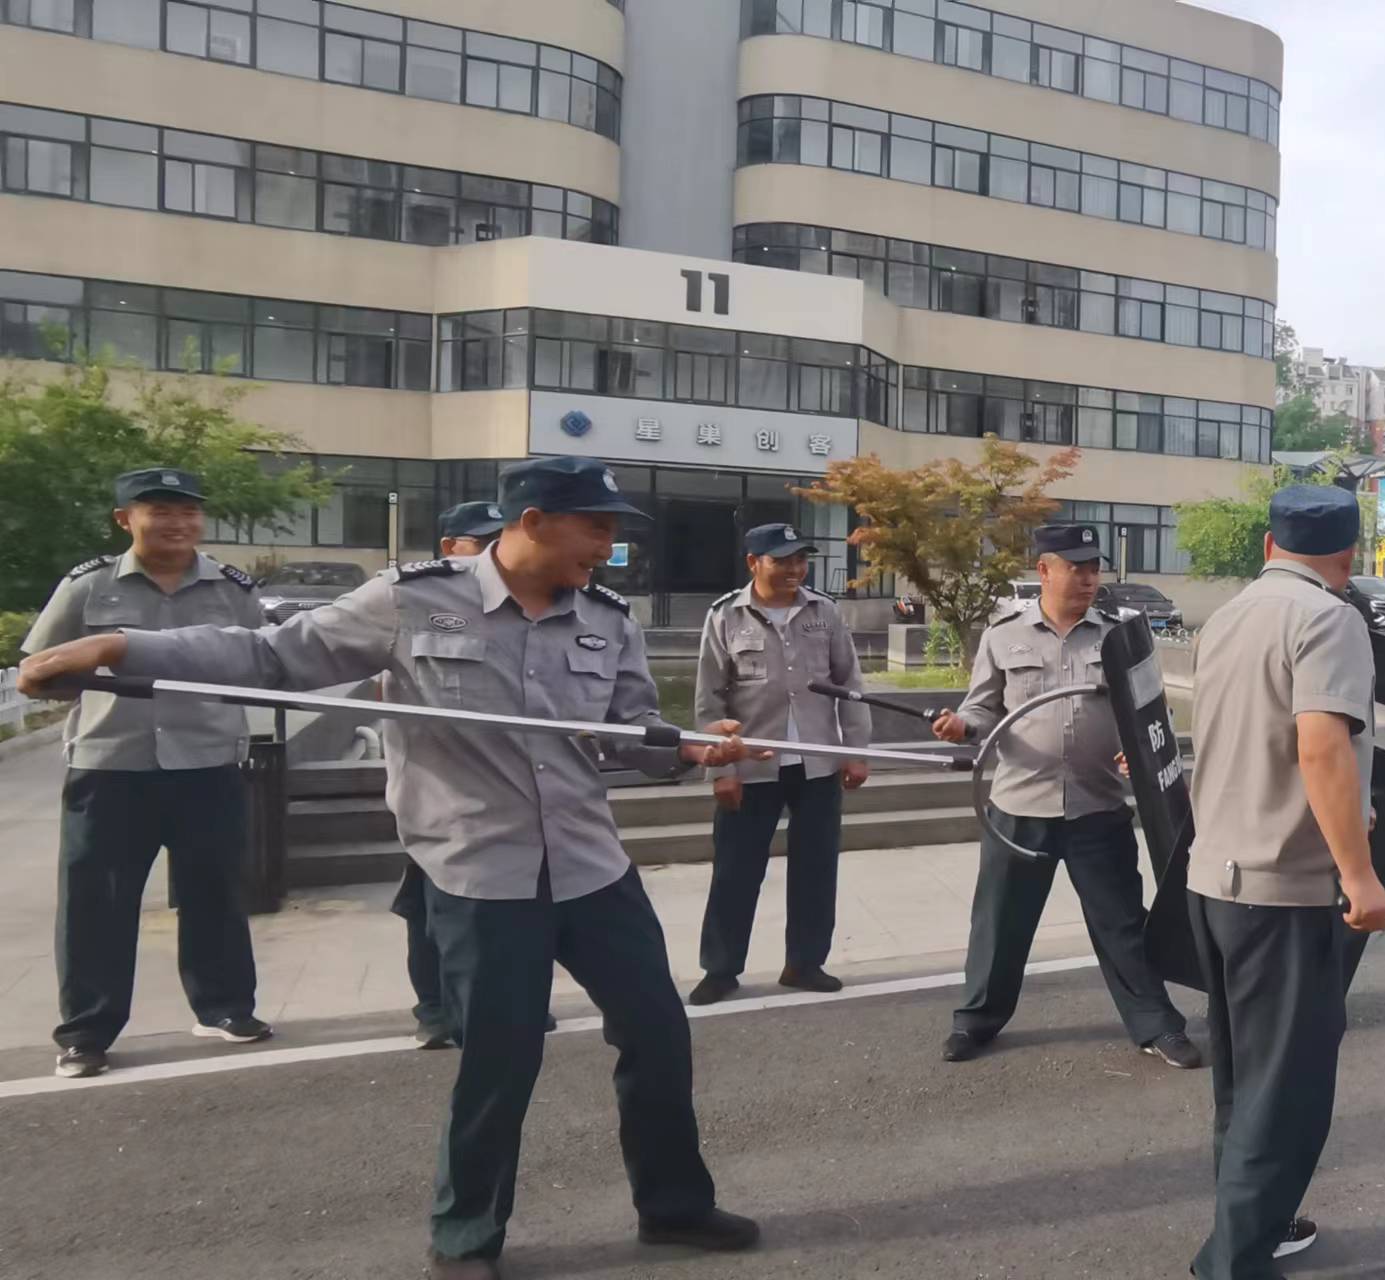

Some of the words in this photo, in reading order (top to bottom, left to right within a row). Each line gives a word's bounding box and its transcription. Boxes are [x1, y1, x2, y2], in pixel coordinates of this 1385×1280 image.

[680, 268, 730, 315] 11
[635, 417, 832, 456] 星巢创客
